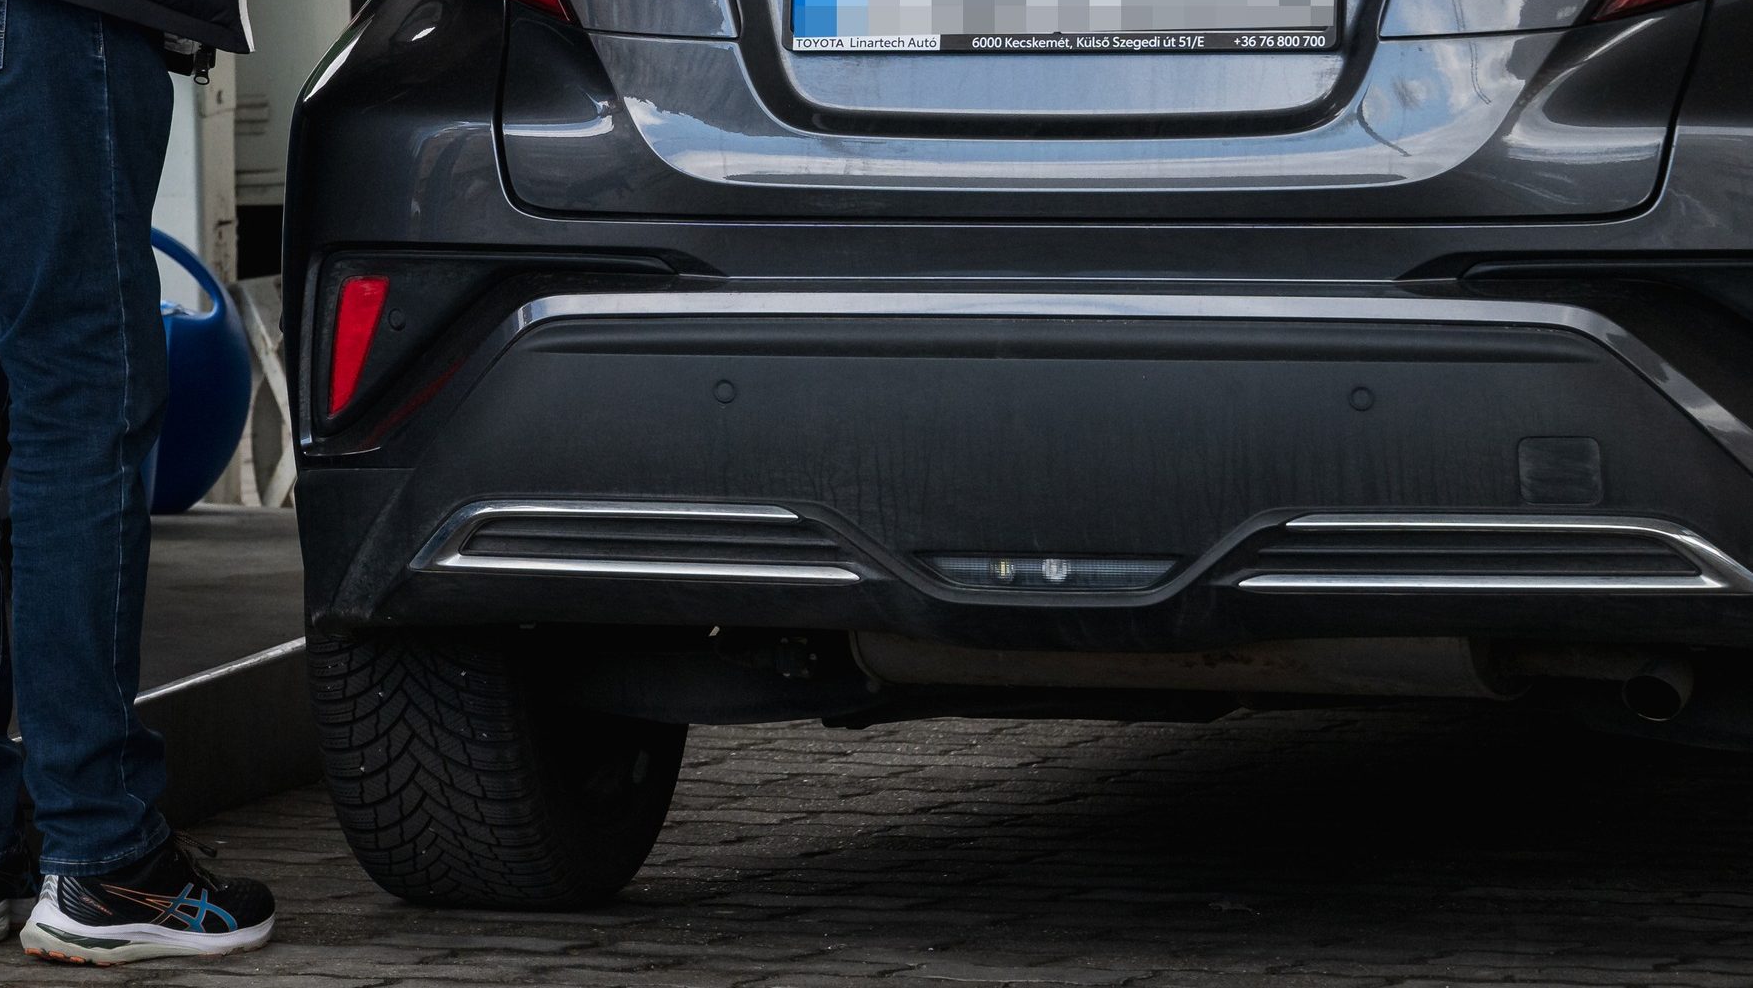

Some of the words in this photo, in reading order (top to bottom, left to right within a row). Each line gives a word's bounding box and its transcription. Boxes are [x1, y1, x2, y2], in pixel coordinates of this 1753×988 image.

[796, 38, 845, 48] TOYOTA
[850, 36, 905, 48] Linartech
[908, 35, 937, 48] Autó
[971, 37, 1002, 48] 6000
[1004, 36, 1074, 50] Kecskemét,
[1076, 35, 1110, 48] Külső
[1112, 35, 1161, 50] Szegedi
[1163, 34, 1176, 47] út
[1178, 35, 1205, 49] 51/E
[1233, 36, 1256, 47] +36
[1259, 36, 1275, 47] 76
[1276, 36, 1301, 47] 800
[1303, 36, 1326, 47] 700
